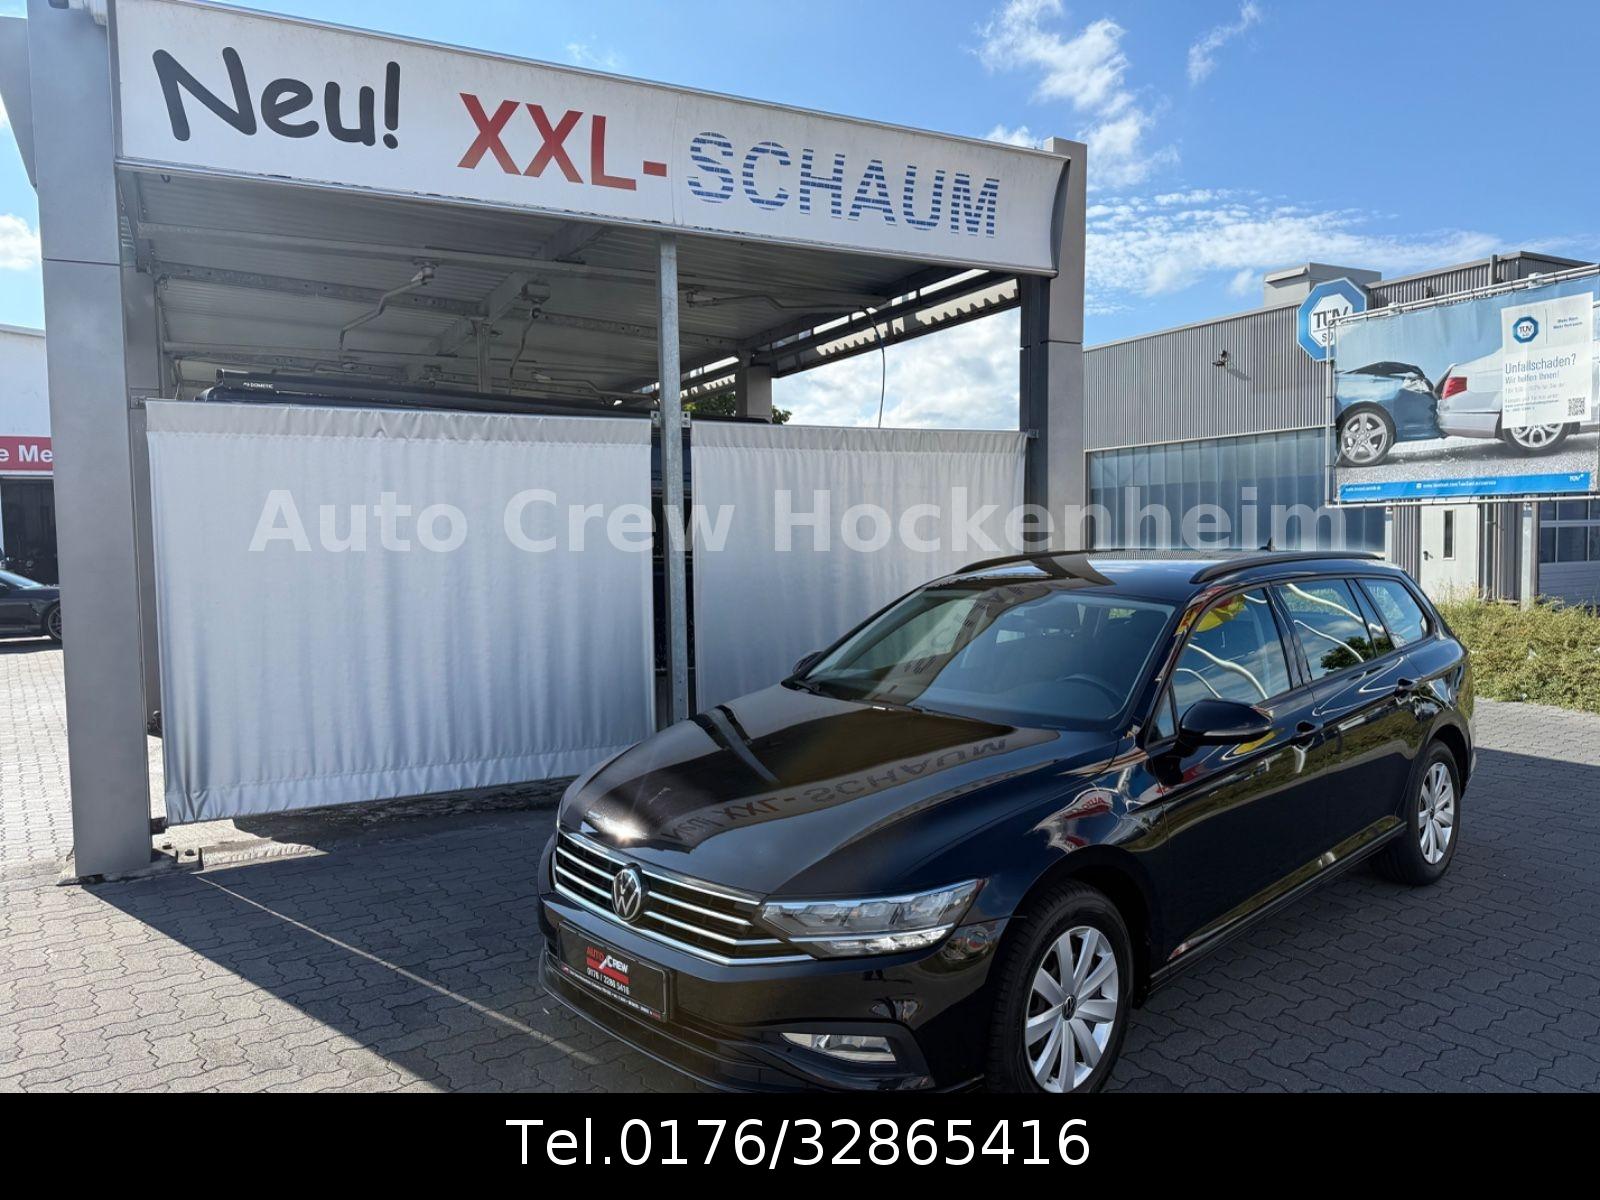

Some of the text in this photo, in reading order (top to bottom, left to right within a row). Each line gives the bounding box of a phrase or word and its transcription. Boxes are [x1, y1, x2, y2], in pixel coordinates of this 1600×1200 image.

[152, 46, 1001, 238] Neu! XXL- SCHAUM
[1505, 353, 1576, 374] Unfallschaden?
